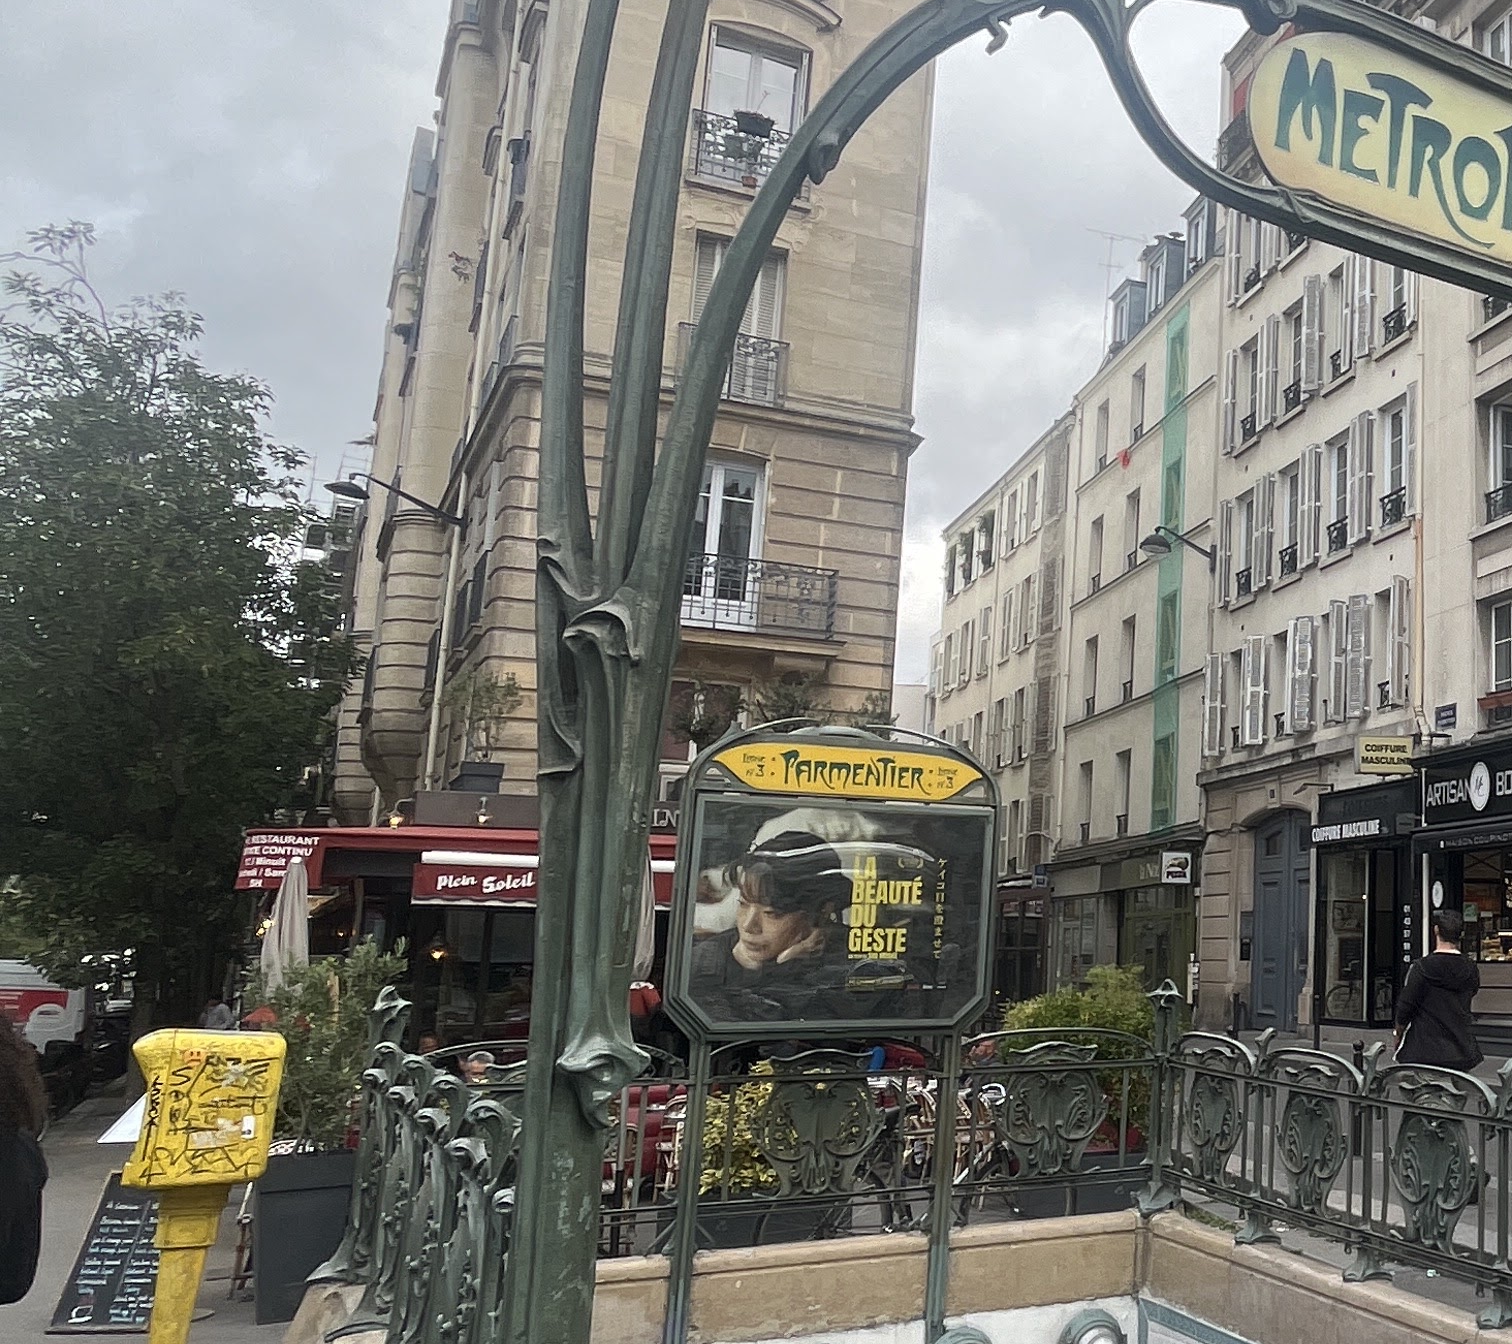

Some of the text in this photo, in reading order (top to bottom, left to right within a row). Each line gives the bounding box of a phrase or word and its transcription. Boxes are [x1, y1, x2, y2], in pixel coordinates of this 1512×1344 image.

[1364, 743, 1408, 754] COIFFURE
[780, 749, 931, 796] PARMENTIER
[1426, 777, 1471, 807] ARTISAN
[261, 846, 313, 856] CONTINU
[853, 856, 877, 880] LA
[436, 872, 536, 894] Plein Soleil
[851, 875, 923, 905] BEAUTÉ
[850, 904, 877, 928] DU
[848, 928, 907, 953] GESTE
